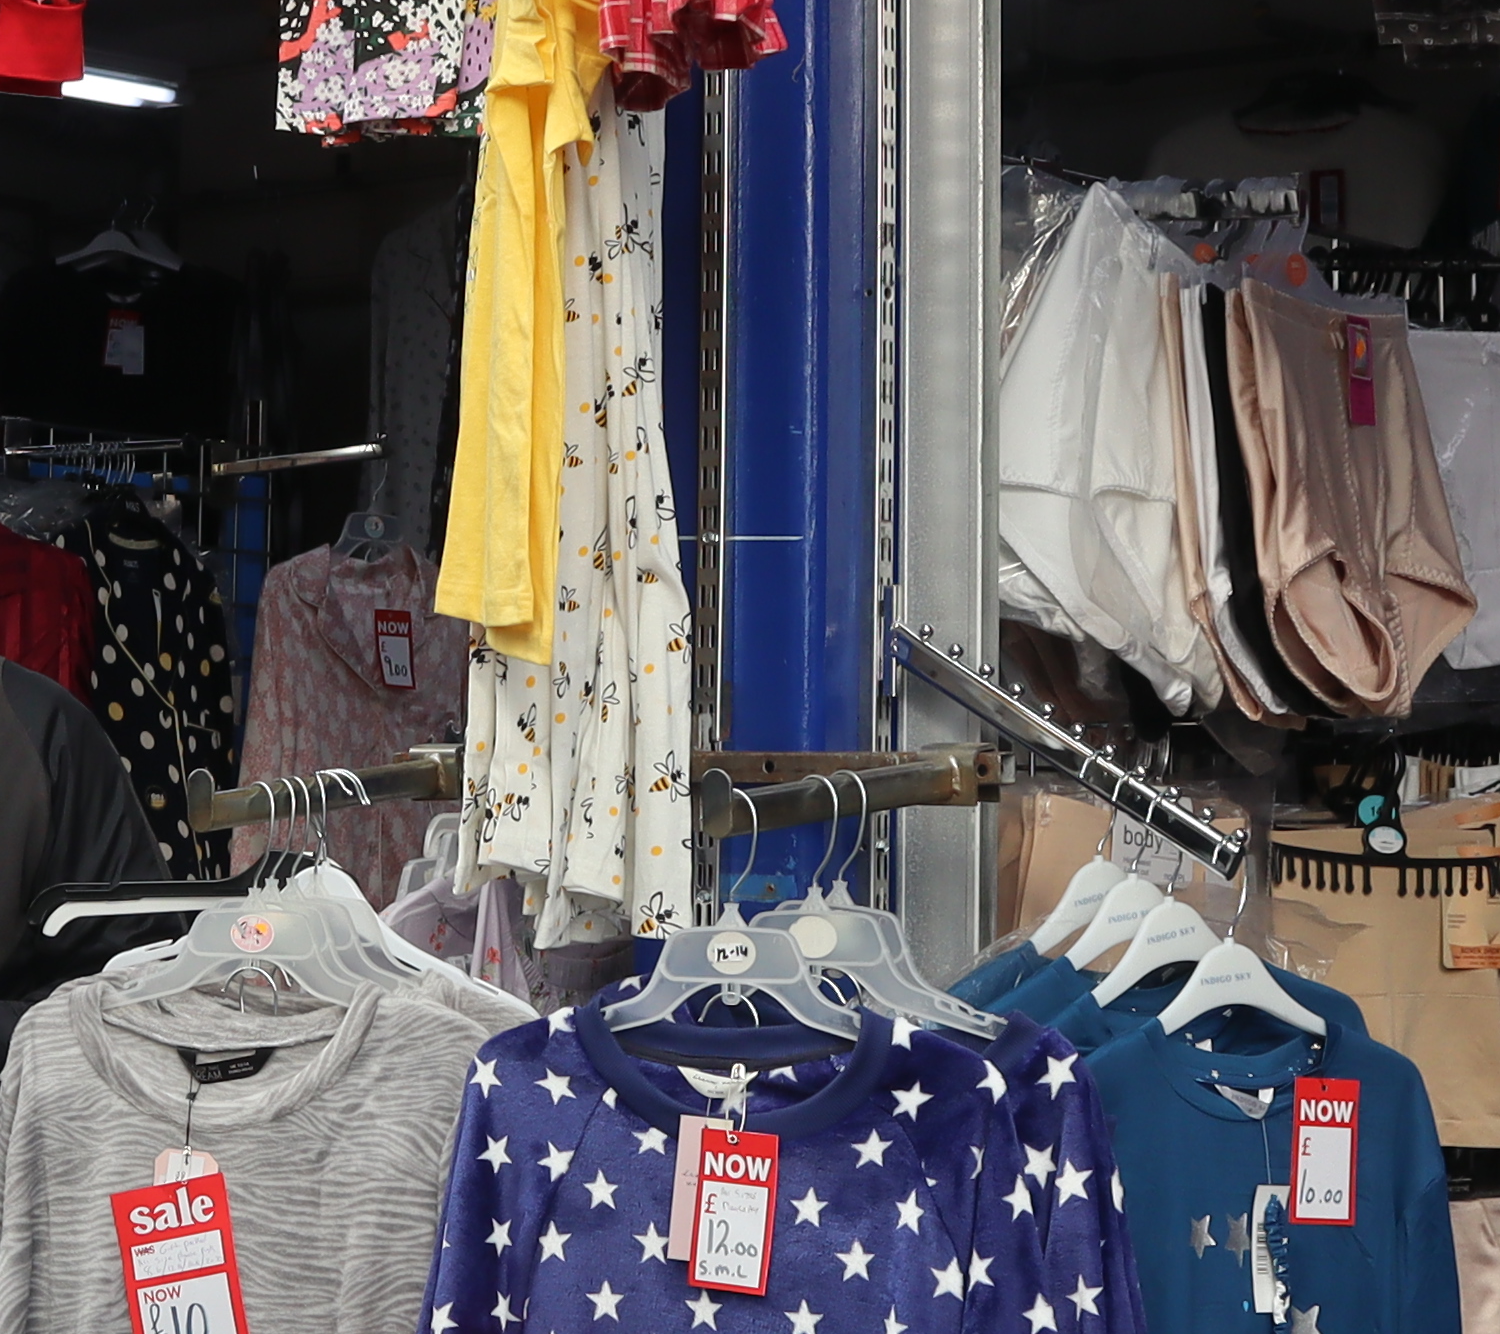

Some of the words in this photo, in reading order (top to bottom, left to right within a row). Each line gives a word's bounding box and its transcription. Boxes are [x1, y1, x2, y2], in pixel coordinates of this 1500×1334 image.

[378, 621, 408, 635] NOW
[1123, 823, 1164, 855] body
[1147, 931, 1177, 945] INDIGO
[1179, 927, 1196, 938] SKY
[1200, 974, 1231, 986] INDIGO
[1234, 971, 1252, 981] SKY
[1300, 1098, 1353, 1124] NOW
[1301, 1136, 1312, 1156] £
[704, 1151, 771, 1182] NOW
[1299, 1169, 1343, 1207] 10.00
[129, 1186, 215, 1235] sale
[704, 1193, 717, 1215] £
[708, 1219, 758, 1258] 12.00
[143, 1285, 182, 1305] NOW
